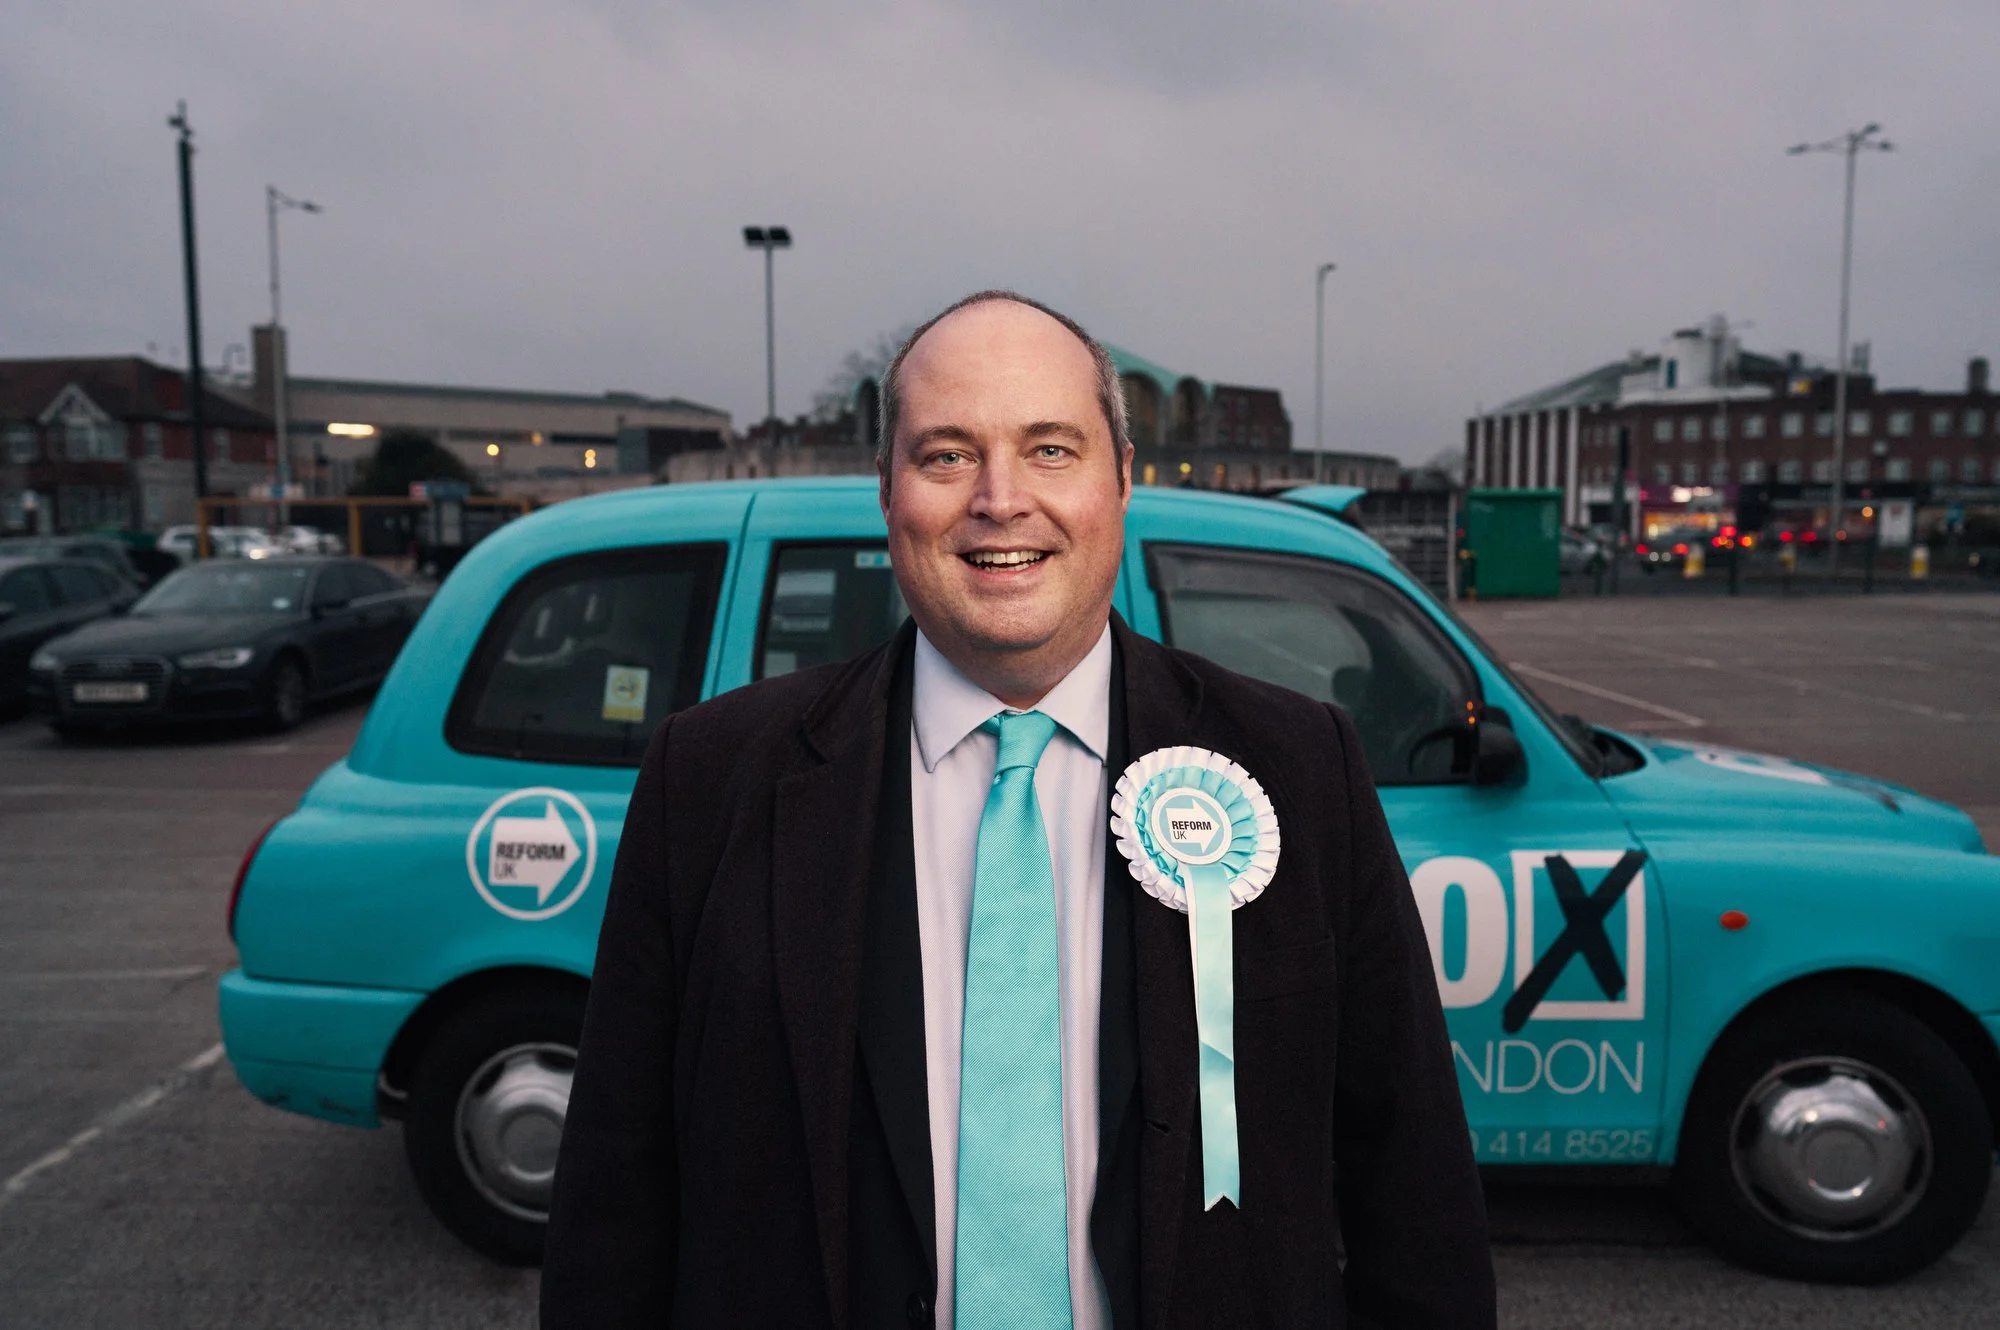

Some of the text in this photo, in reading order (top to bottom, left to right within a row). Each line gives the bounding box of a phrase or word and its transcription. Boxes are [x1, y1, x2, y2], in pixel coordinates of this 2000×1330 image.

[1171, 820, 1212, 831] REFORM
[1173, 831, 1187, 840] UK
[496, 842, 566, 861] REFORM
[494, 862, 517, 880] UK
[1489, 1130, 1552, 1158] 414
[1564, 1129, 1654, 1160] 8525
